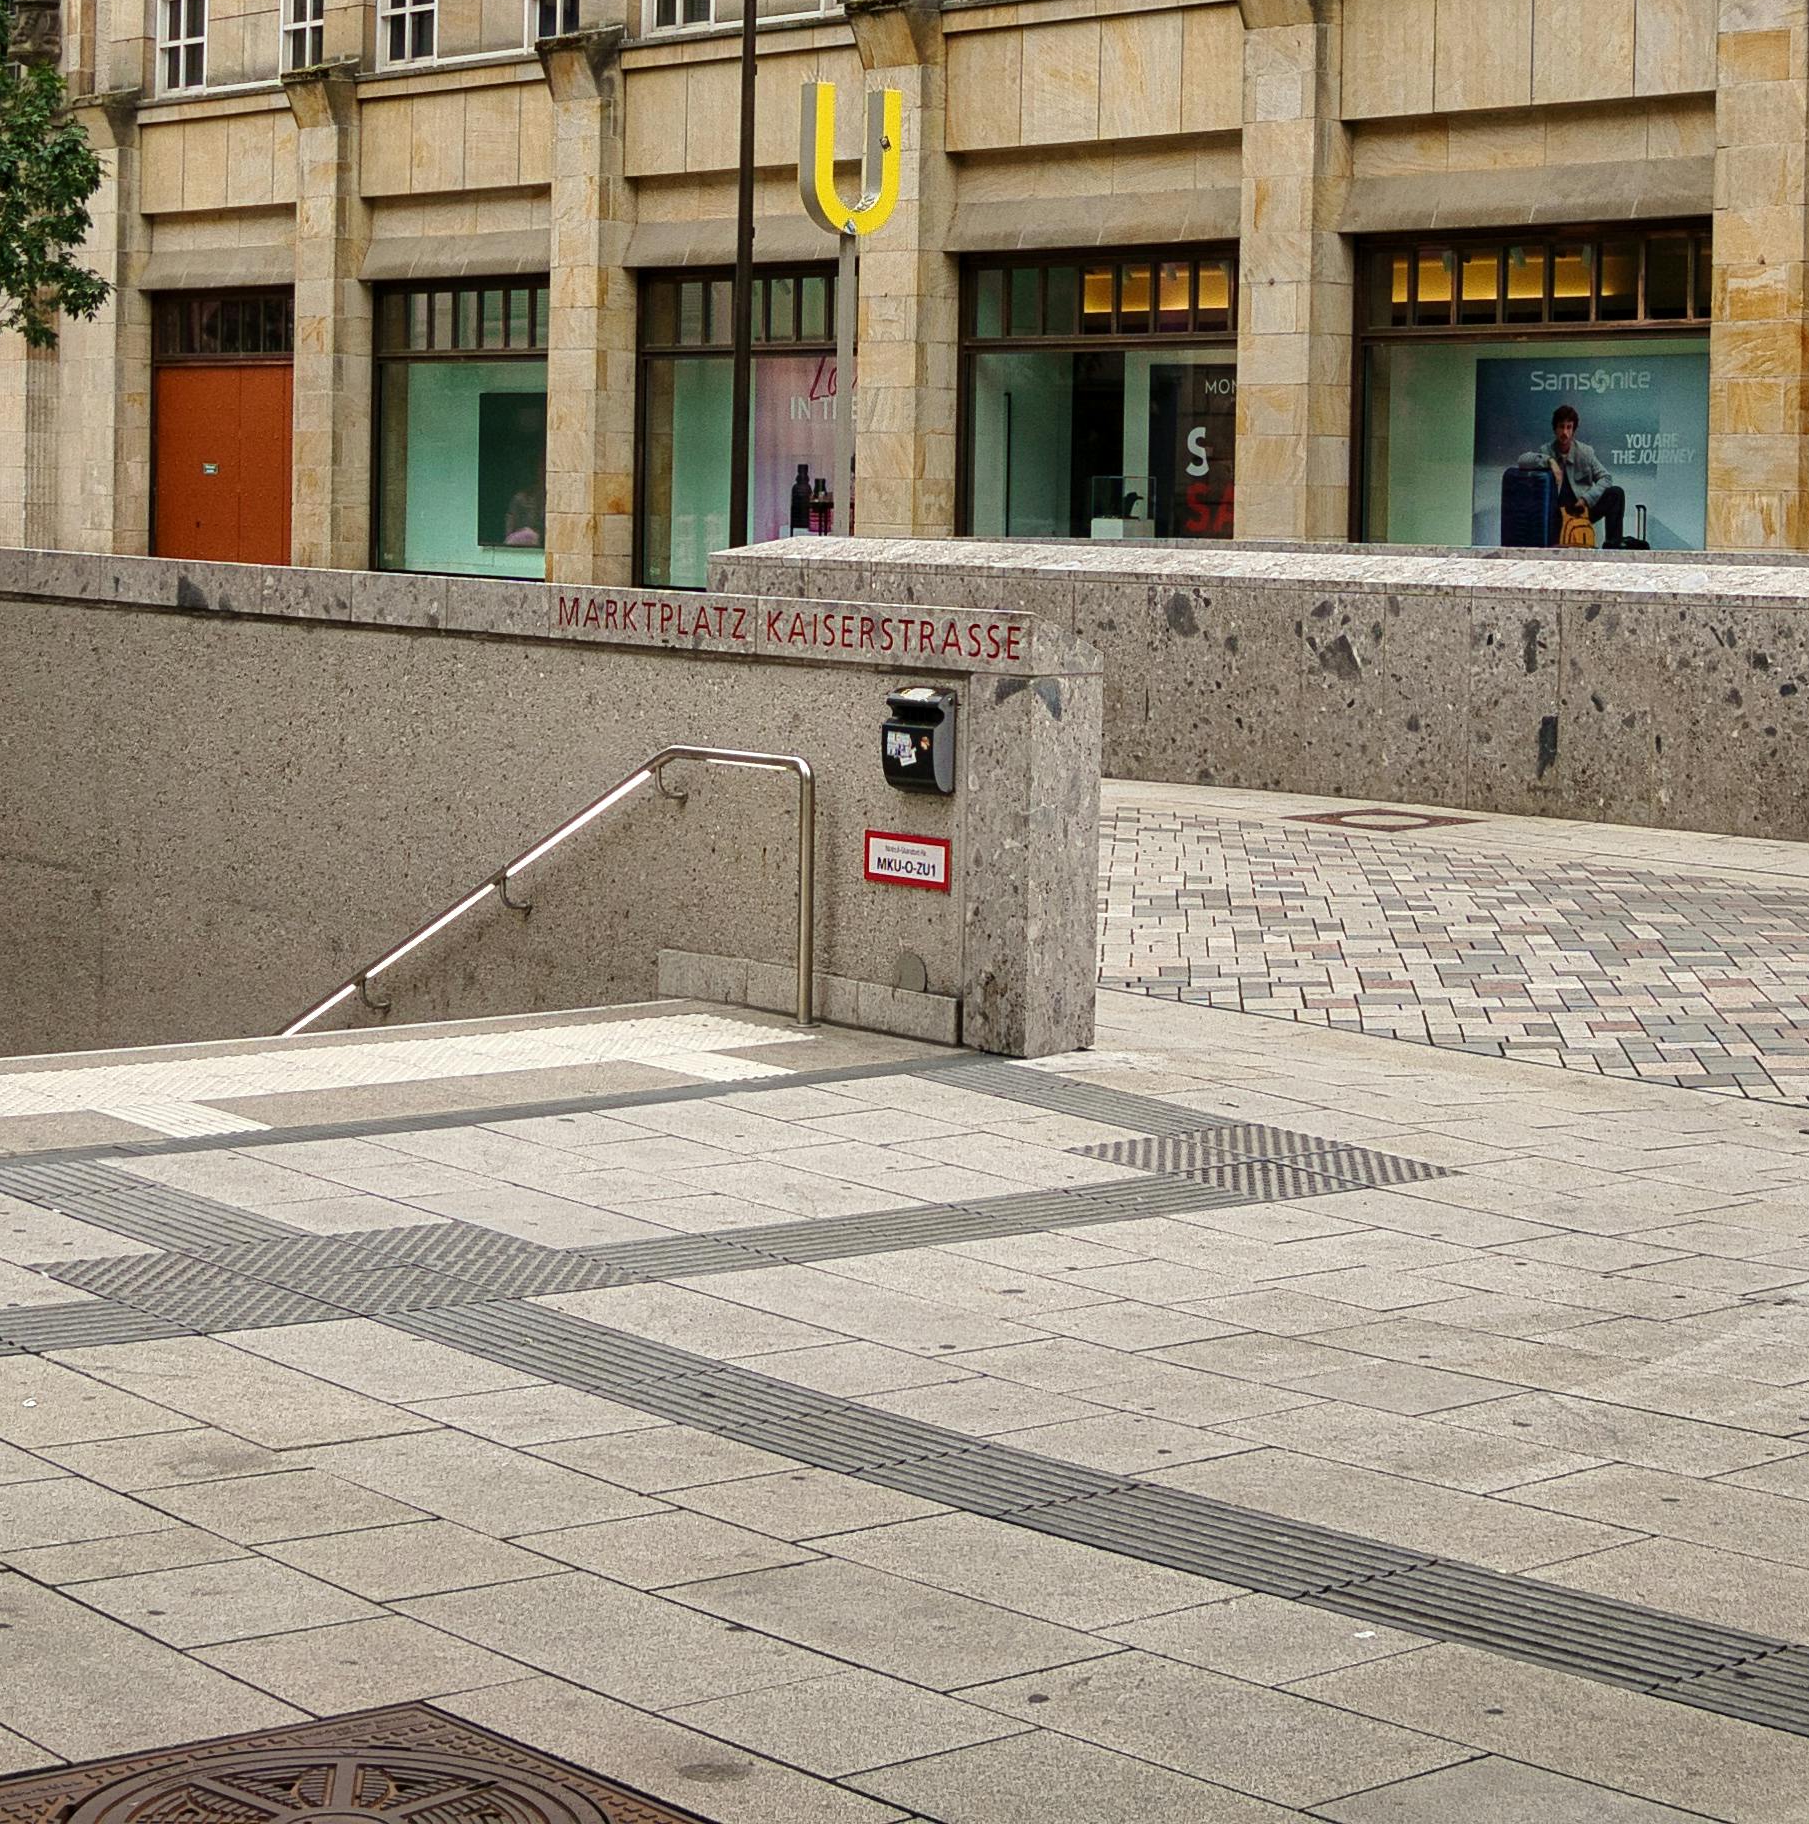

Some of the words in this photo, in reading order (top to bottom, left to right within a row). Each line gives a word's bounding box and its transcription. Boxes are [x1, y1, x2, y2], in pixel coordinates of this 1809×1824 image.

[801, 81, 902, 236] U
[1529, 369, 1652, 394] Samsonite
[790, 396, 812, 420] IN
[1185, 426, 1210, 477] S
[1626, 433, 1651, 449] YOU
[1653, 432, 1680, 448] ARE
[1611, 449, 1635, 465] THE
[1636, 449, 1696, 465] JOURNEY
[557, 596, 747, 641] MARKTPLATZ
[767, 609, 1022, 661] KAISERSTRASSE
[876, 856, 937, 878] MKU-O-ZU1
